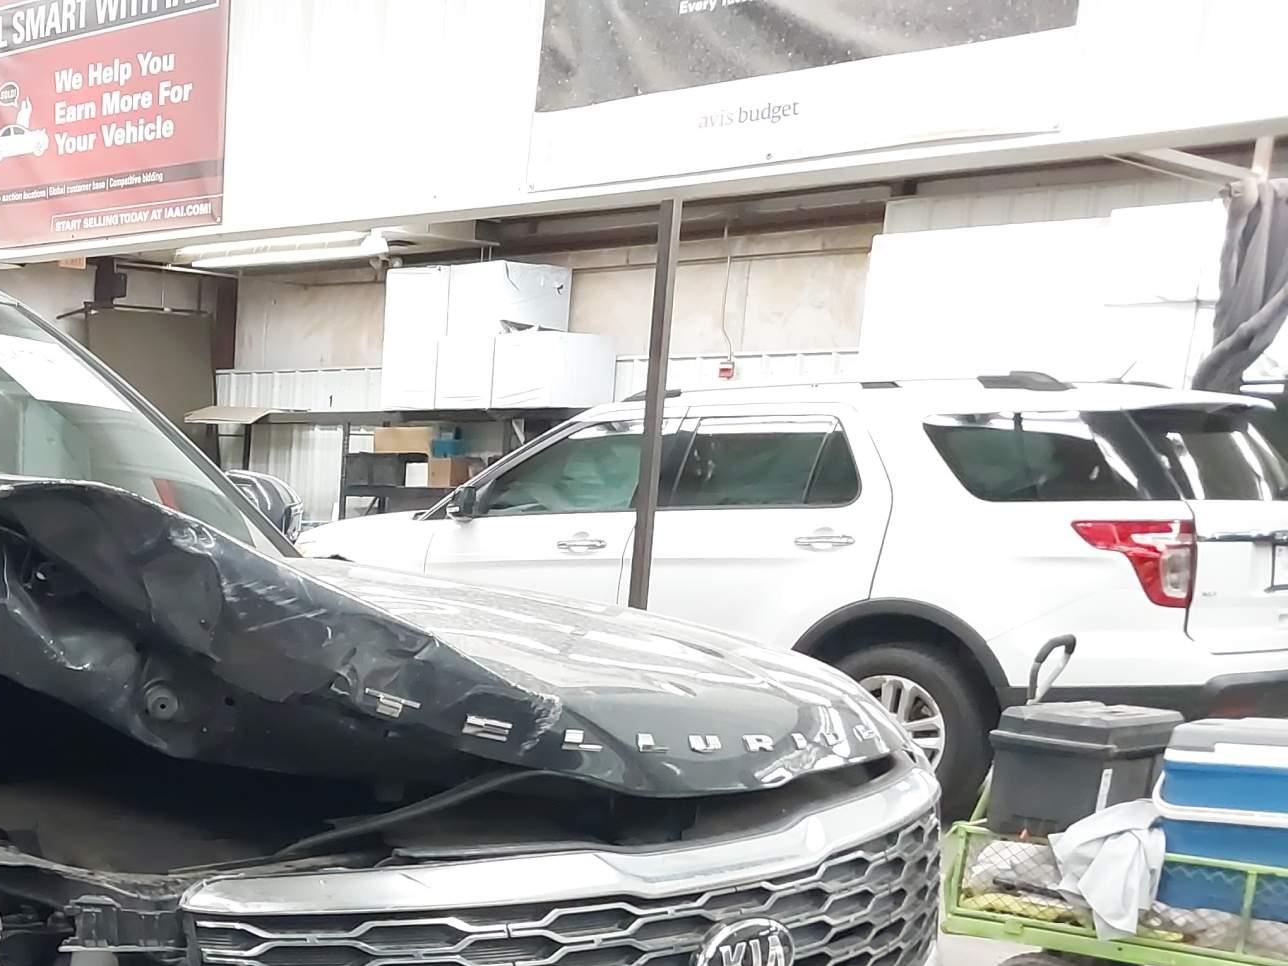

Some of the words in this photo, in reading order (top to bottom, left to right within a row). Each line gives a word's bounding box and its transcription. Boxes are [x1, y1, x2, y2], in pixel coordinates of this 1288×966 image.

[11, 0, 87, 45] SMART
[678, 0, 717, 15] Every
[54, 68, 83, 94] We
[87, 57, 133, 87] Help
[136, 51, 176, 77] You
[54, 100, 97, 125] Earn
[101, 90, 153, 117] More
[158, 80, 193, 106] For
[698, 110, 734, 129] avis
[737, 101, 800, 124] budget
[54, 132, 97, 156] Your
[100, 115, 175, 148] Vehicle
[55, 218, 82, 232] START
[83, 214, 119, 230] SELLING
[119, 210, 150, 224] TODAY
[150, 208, 163, 221] AT
[164, 202, 212, 219] IAAI.COM!
